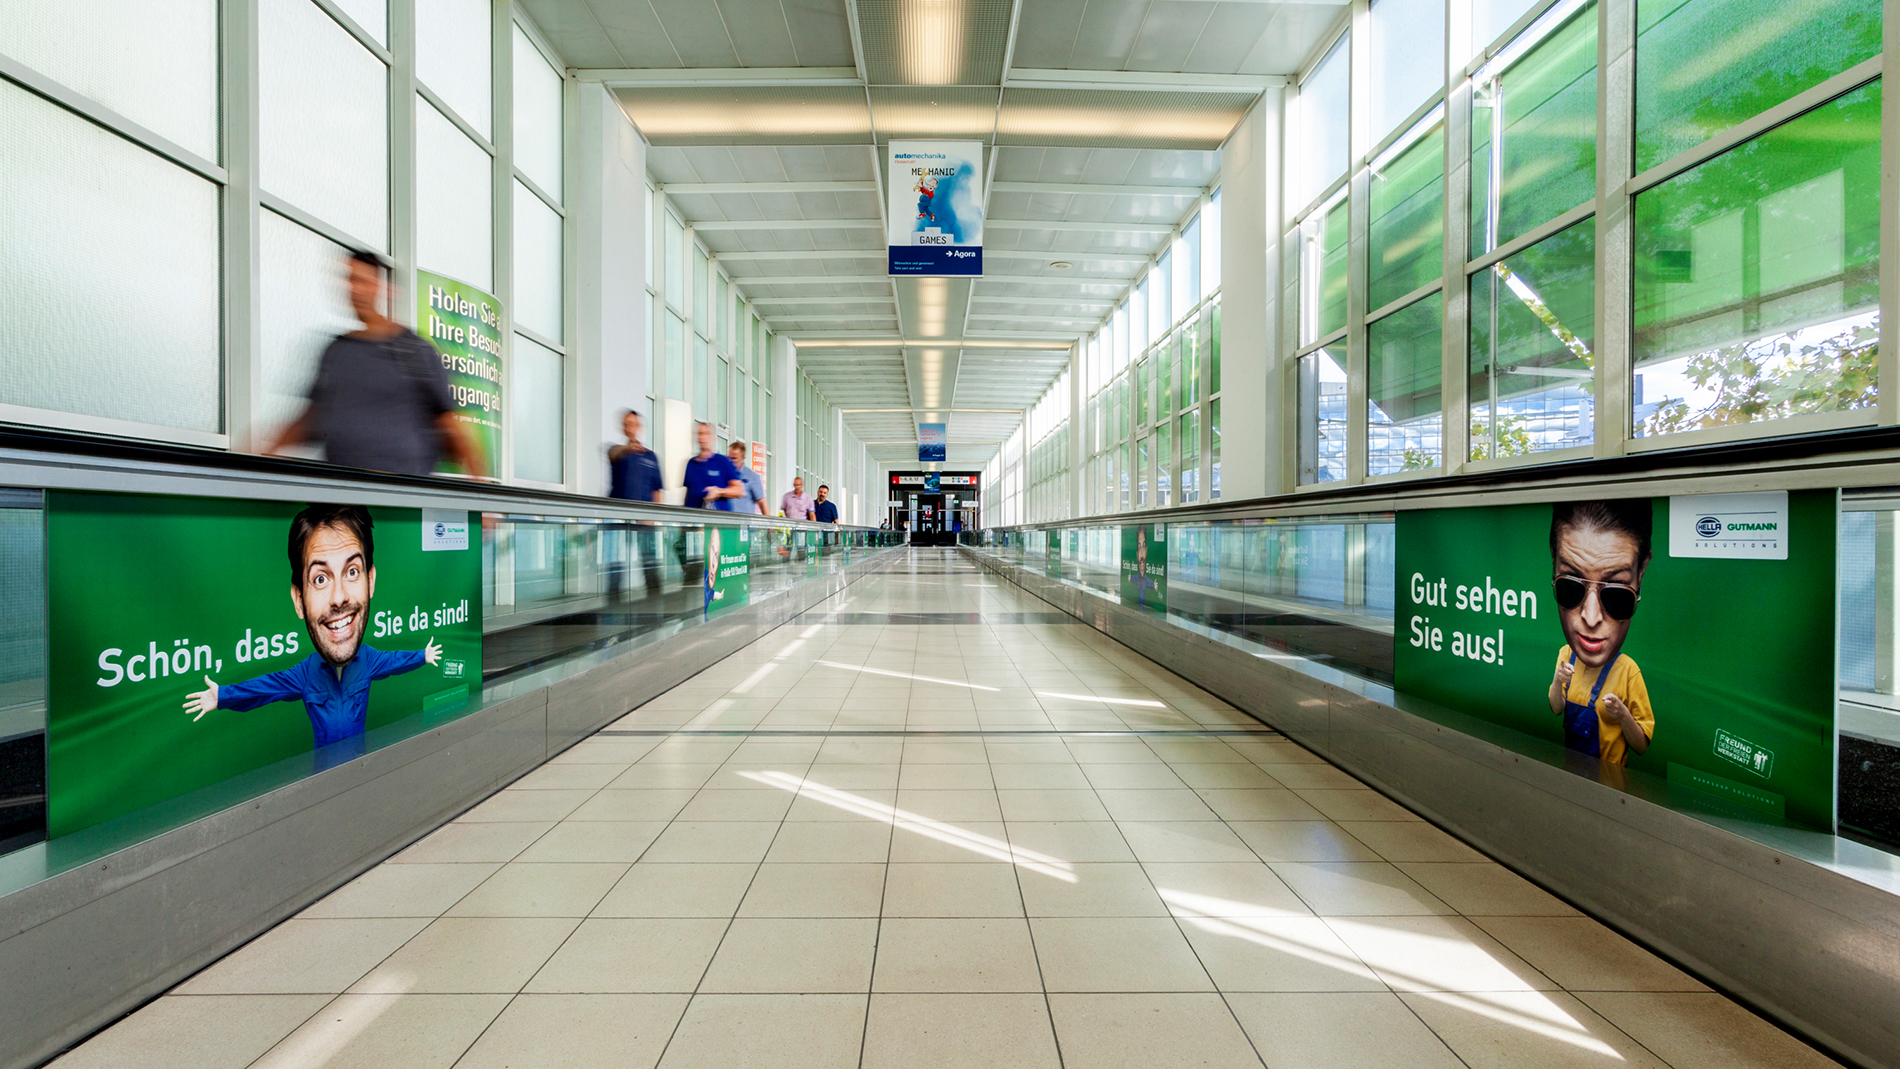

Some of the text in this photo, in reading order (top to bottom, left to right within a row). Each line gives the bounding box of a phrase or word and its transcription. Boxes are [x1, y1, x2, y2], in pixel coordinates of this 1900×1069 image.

[919, 235, 947, 244] GAMES
[953, 250, 976, 259] Agora
[429, 284, 477, 319] Holen
[481, 301, 496, 328] Sie
[429, 314, 464, 343] Ihre
[440, 353, 498, 384] ersönlich
[447, 383, 490, 412] ngang
[1727, 523, 1777, 531] GUTMANN
[1411, 572, 1537, 620] Gut sehen
[373, 599, 468, 638] Sie da sind!
[1410, 615, 1504, 666] Sie aus!
[96, 628, 299, 688] Schön, dass
[1718, 746, 1750, 765] WERKSTATT
[1720, 734, 1752, 754] FREUND
